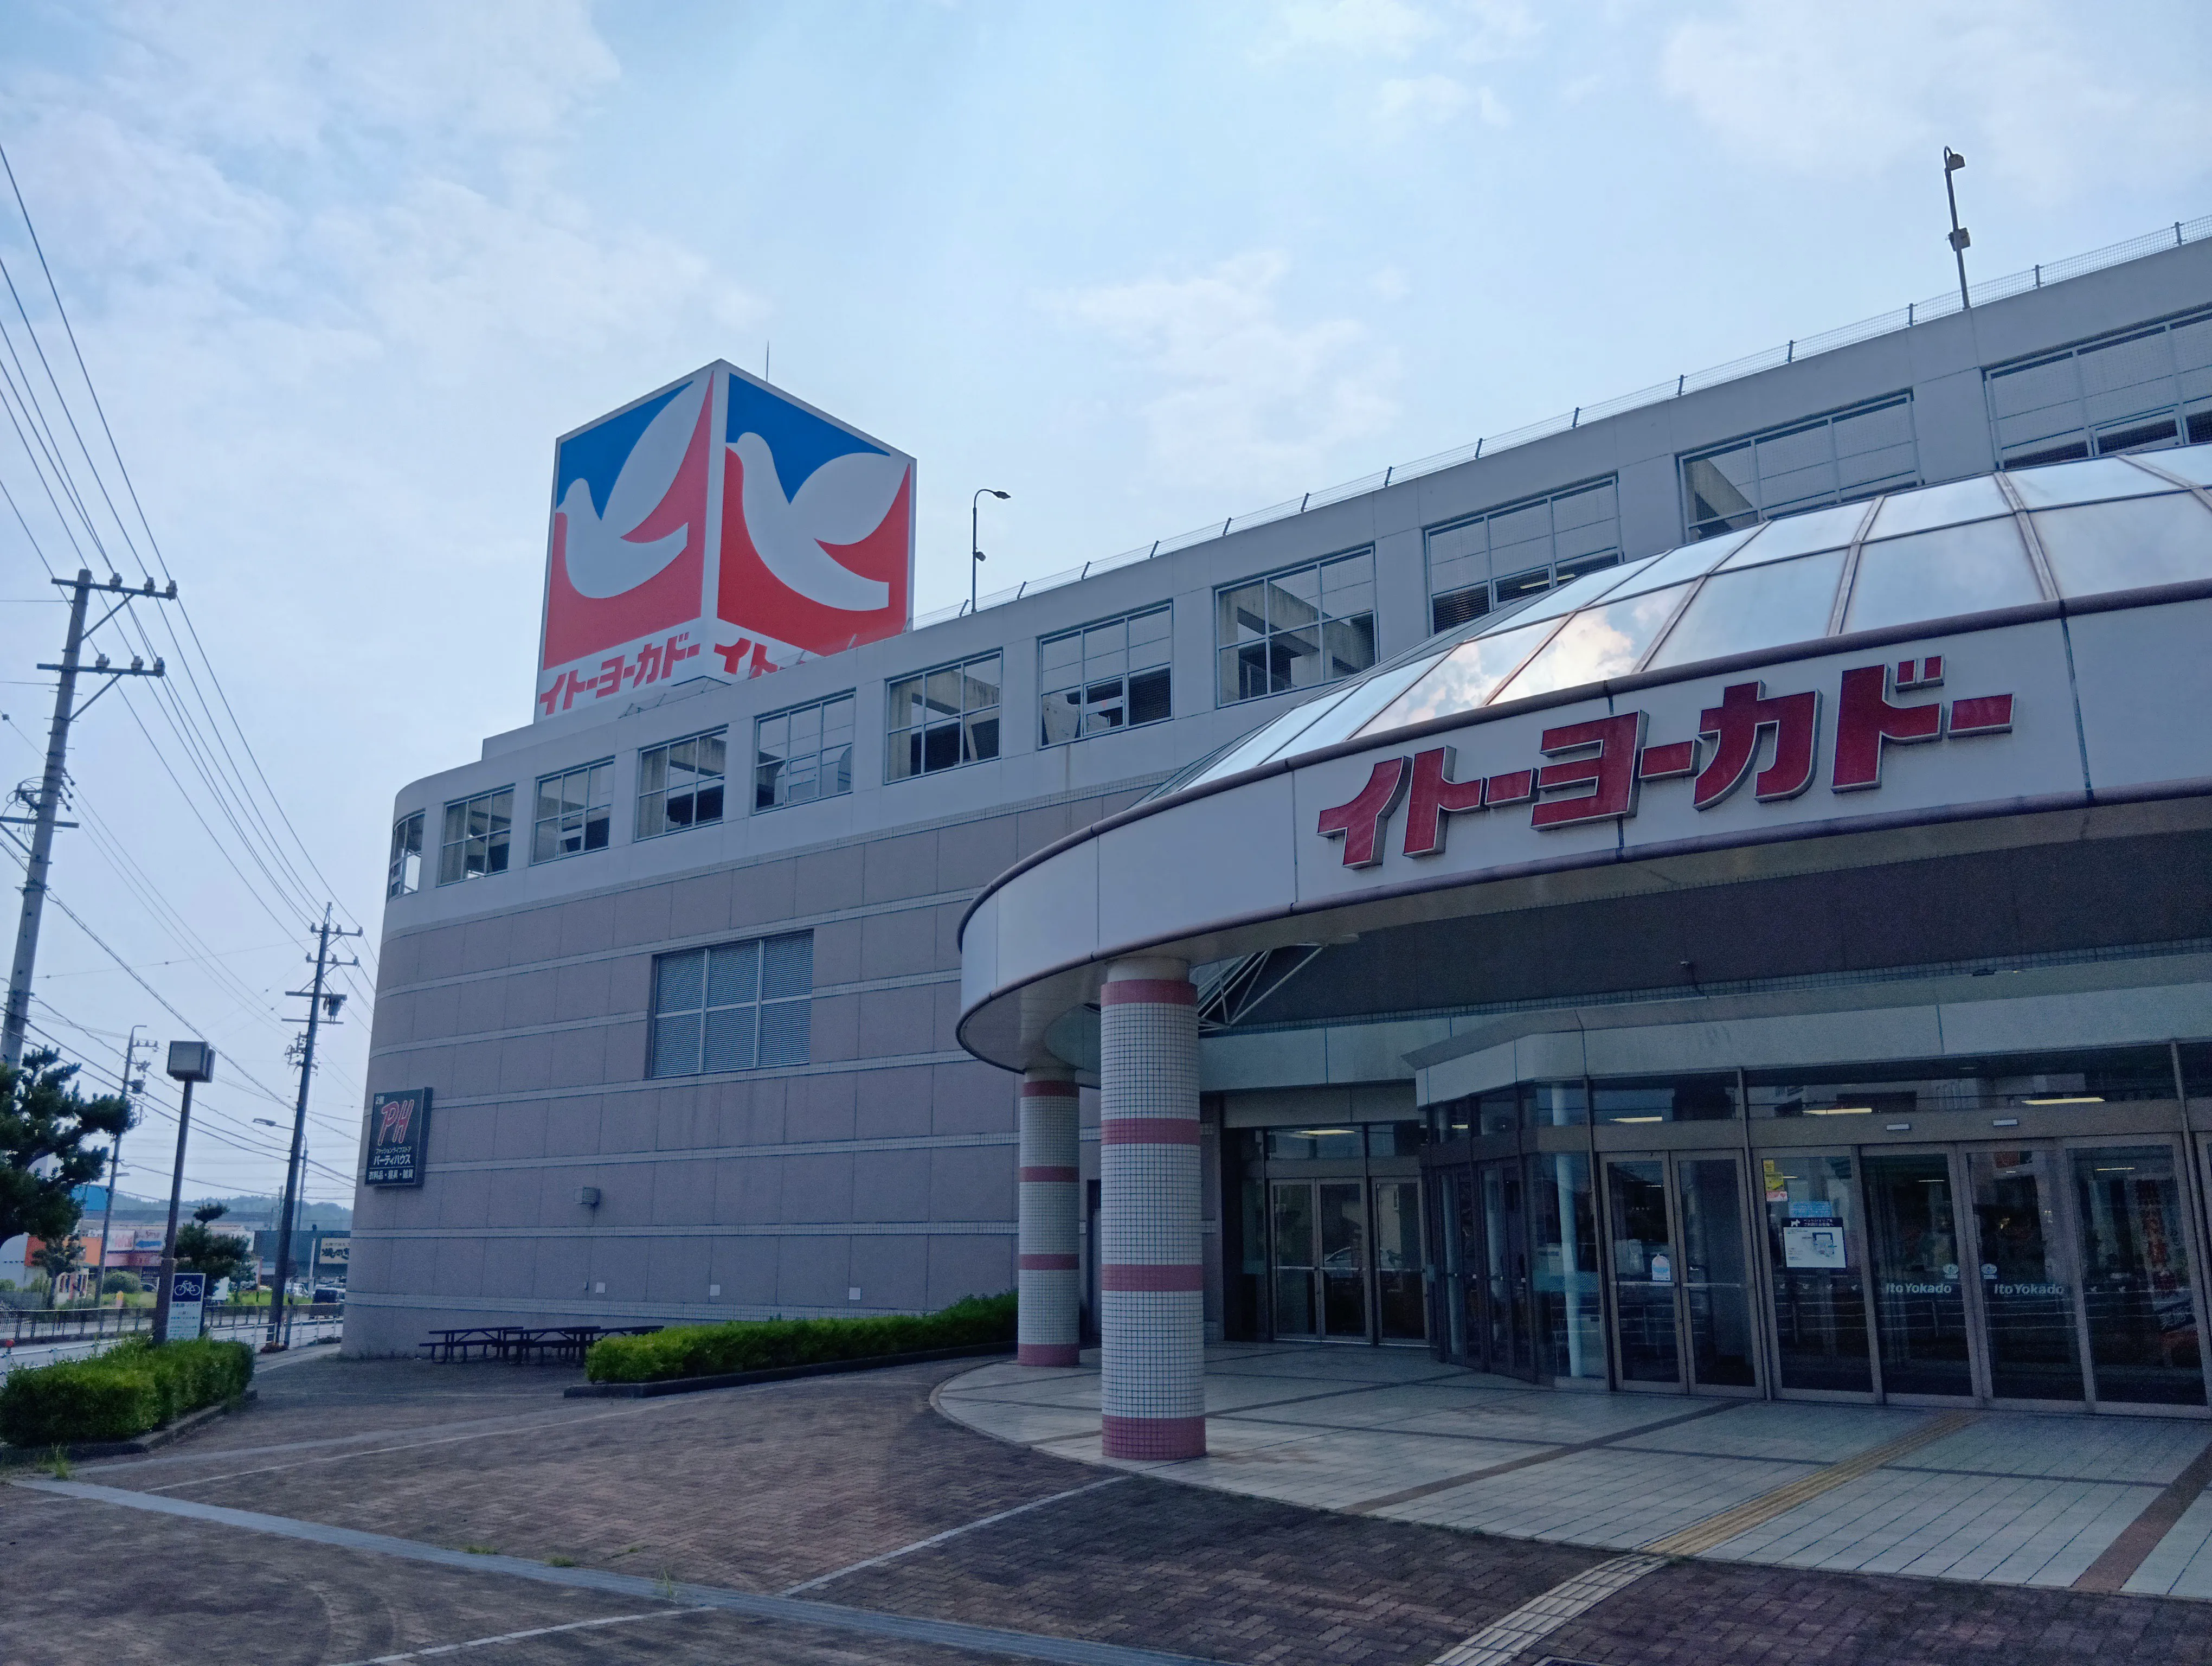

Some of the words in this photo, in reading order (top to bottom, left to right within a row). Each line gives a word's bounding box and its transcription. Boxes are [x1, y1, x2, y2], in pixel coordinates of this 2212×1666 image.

[539, 632, 700, 716] イトーヨーカドー
[1316, 653, 2015, 869] イトーヨーカドー
[378, 1099, 414, 1146] PH
[374, 1154, 411, 1165] パーティハウス
[1886, 1283, 1904, 1294] Ito
[1905, 1283, 1952, 1293] Yokado
[1994, 1284, 2013, 1295] Ito
[2014, 1283, 2065, 1295] Yokado
